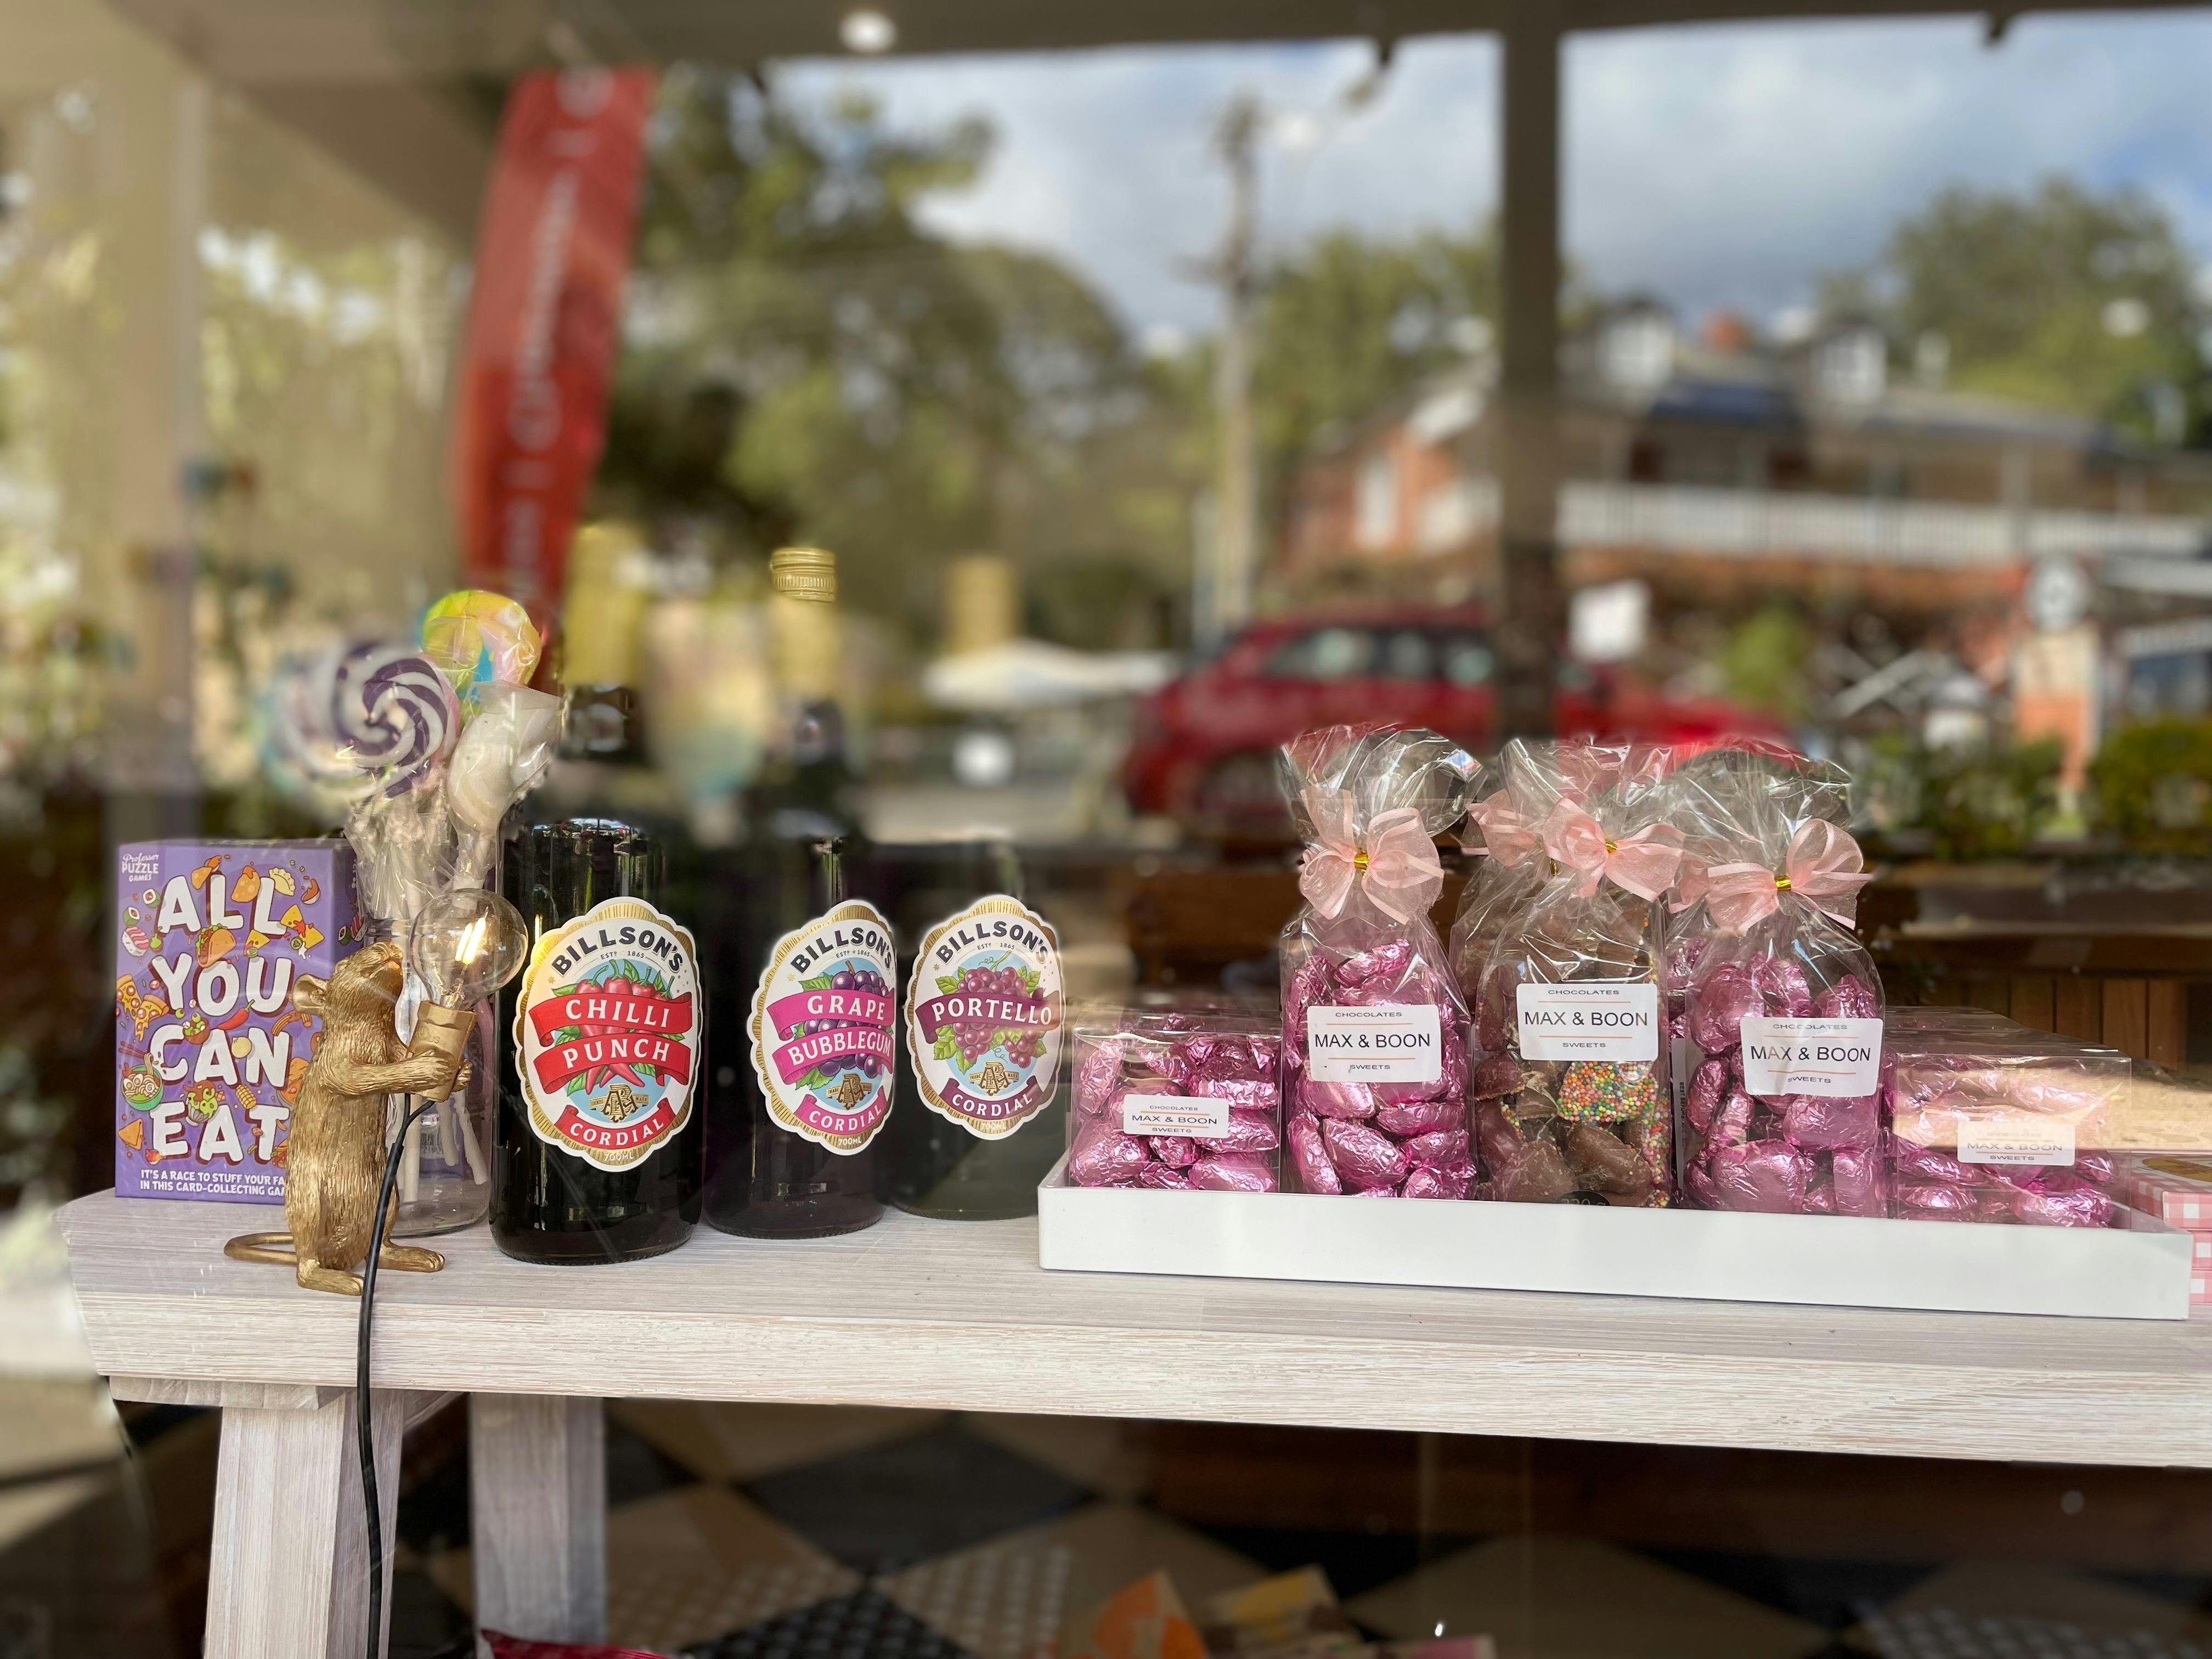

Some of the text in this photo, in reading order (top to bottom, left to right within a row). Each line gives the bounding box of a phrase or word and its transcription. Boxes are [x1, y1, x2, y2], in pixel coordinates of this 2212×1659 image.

[122, 861, 159, 874] PUZZLE
[123, 853, 159, 865] Professor
[129, 874, 151, 882] GAMES
[156, 873, 289, 937] ALL
[551, 926, 684, 977] BILLSON'S
[790, 927, 893, 974] BILLSON'S
[935, 921, 1049, 964] BILLSON'S
[151, 952, 293, 1017] YOU
[565, 998, 671, 1028] CHILLI
[807, 995, 885, 1022] GRAPE
[931, 997, 1052, 1025] PORTELLO
[1525, 1012, 1647, 1026] MAX & BOON
[562, 1038, 670, 1069] PUNCH
[787, 1030, 891, 1066] BUBBLEGUM
[1314, 1034, 1430, 1048] MAX & BOON
[1751, 1046, 1871, 1062] MAX & BOON
[149, 1024, 290, 1088] CAN
[809, 1105, 882, 1132] CORDIAL
[951, 1092, 1033, 1118] CORDIAL
[149, 1101, 290, 1163] EAT
[569, 1118, 665, 1147] CORDIAL
[839, 1137, 862, 1146] 700ML
[605, 1152, 634, 1162] 700ML
[140, 1181, 150, 1190] IN
[152, 1181, 173, 1191] THIS
[176, 1181, 265, 1195] CARD-COLLECTING
[141, 1169, 286, 1186] IT'S A RACE TO STUFF YOUR FA
